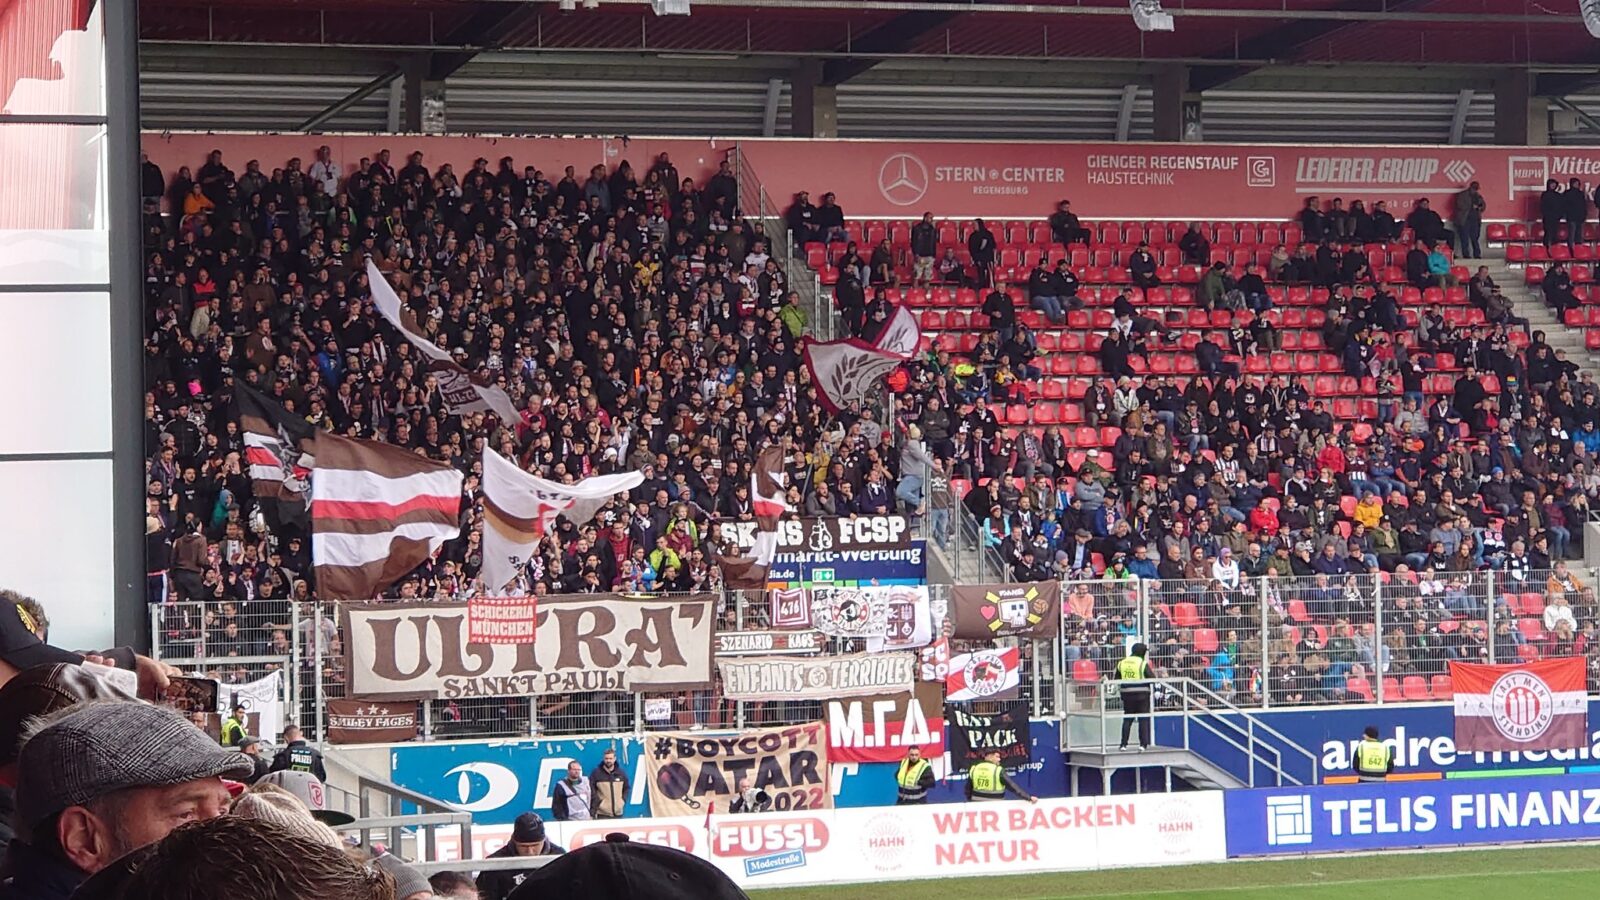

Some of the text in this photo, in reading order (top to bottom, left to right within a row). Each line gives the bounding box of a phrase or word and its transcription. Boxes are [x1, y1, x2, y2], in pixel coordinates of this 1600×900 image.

[1087, 155, 1239, 170] GIENGER REGENSTAUF
[1296, 157, 1439, 184] LEDERER.GROUP
[935, 167, 1065, 183] STERN CENTER
[1087, 171, 1175, 185] HAUSTECHNIK
[972, 185, 1029, 195] REGENSBURG
[720, 516, 906, 548] SKNS FCSP
[471, 604, 534, 619] SCHICKERIA
[471, 617, 534, 636] MÜNCHEN
[720, 634, 773, 650] SZENARIO
[443, 670, 626, 698] SANKT PAULI
[726, 656, 914, 694] ENFANTS TERRIBLES
[1496, 677, 1547, 698] LAST MEN
[329, 717, 373, 728] SMILEY
[1498, 714, 1548, 737] STANDING
[653, 725, 821, 760] #BOYCOTT
[968, 728, 1018, 748] PACK
[932, 810, 1000, 835] WIR
[1008, 803, 1136, 831] BACKEN
[1323, 788, 1600, 836] TELIS FINANZ
[1158, 821, 1193, 833] HAHN
[720, 823, 822, 852] FUSSL
[869, 836, 905, 848] HAHN
[750, 852, 801, 871] Modestraße
[935, 839, 1040, 866] NATUR
